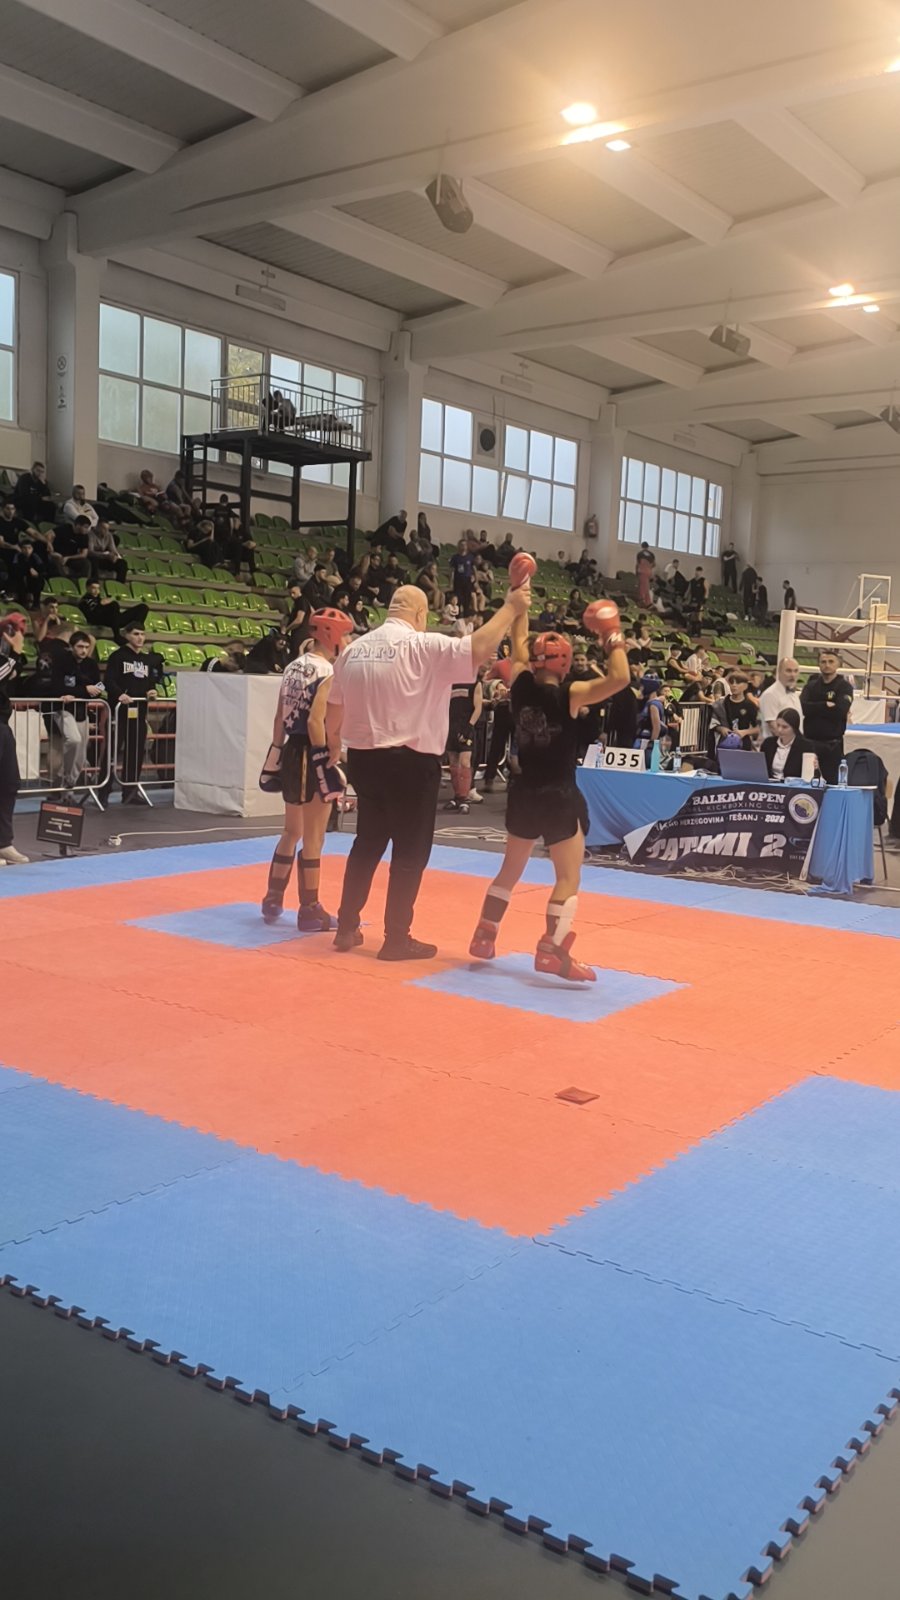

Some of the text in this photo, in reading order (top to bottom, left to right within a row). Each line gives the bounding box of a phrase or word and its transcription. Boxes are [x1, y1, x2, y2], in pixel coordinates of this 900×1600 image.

[605, 751, 640, 768] 035
[692, 791, 786, 806] BALKAN OPEN
[706, 801, 762, 811] KICKBOXING
[728, 812, 758, 822] TEŠANJ
[646, 832, 787, 861] TATAMI 2
